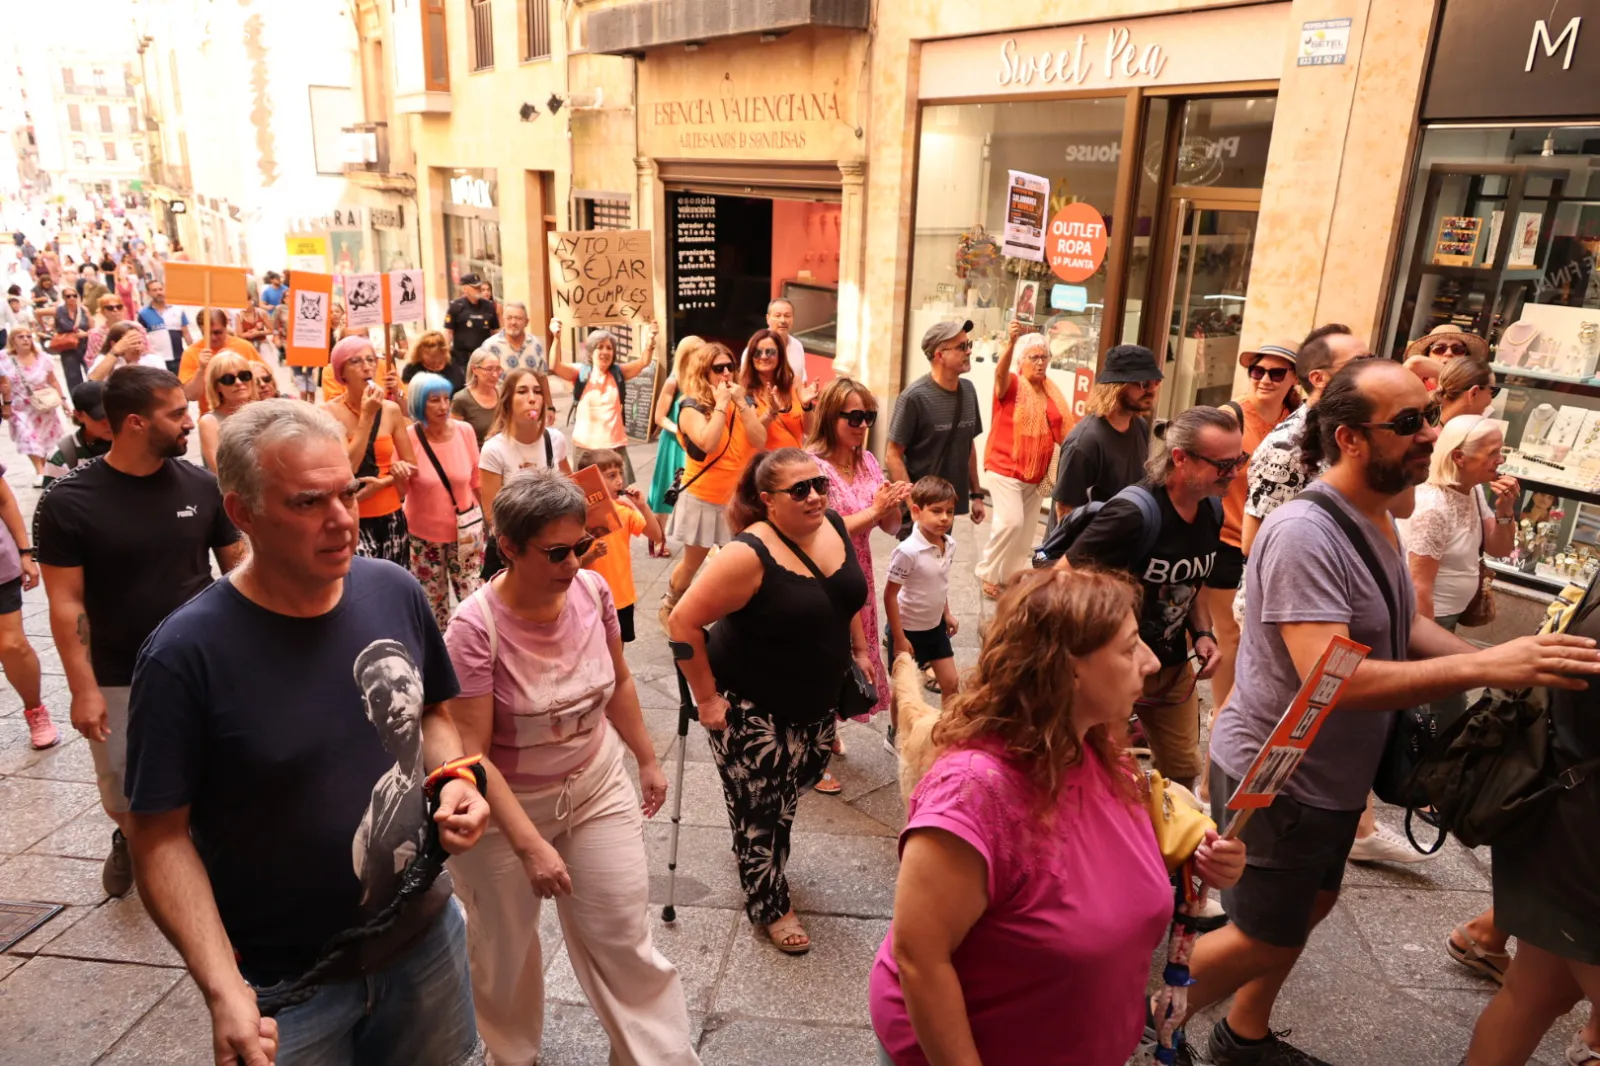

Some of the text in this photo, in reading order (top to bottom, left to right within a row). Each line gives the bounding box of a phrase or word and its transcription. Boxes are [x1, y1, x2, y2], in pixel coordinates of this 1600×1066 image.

[1524, 16, 1583, 73] M
[997, 26, 1168, 87] Sweet Pea
[654, 92, 841, 126] ESENCIA VALENCIANA
[679, 131, 736, 149] ARTESANOS
[749, 130, 806, 149] SONRISAS
[1052, 220, 1102, 239] OUTLET
[554, 236, 639, 255] AYTO DE
[1057, 239, 1092, 256] ROPA
[1063, 257, 1094, 270] PLANTA
[604, 303, 642, 319] LEY
